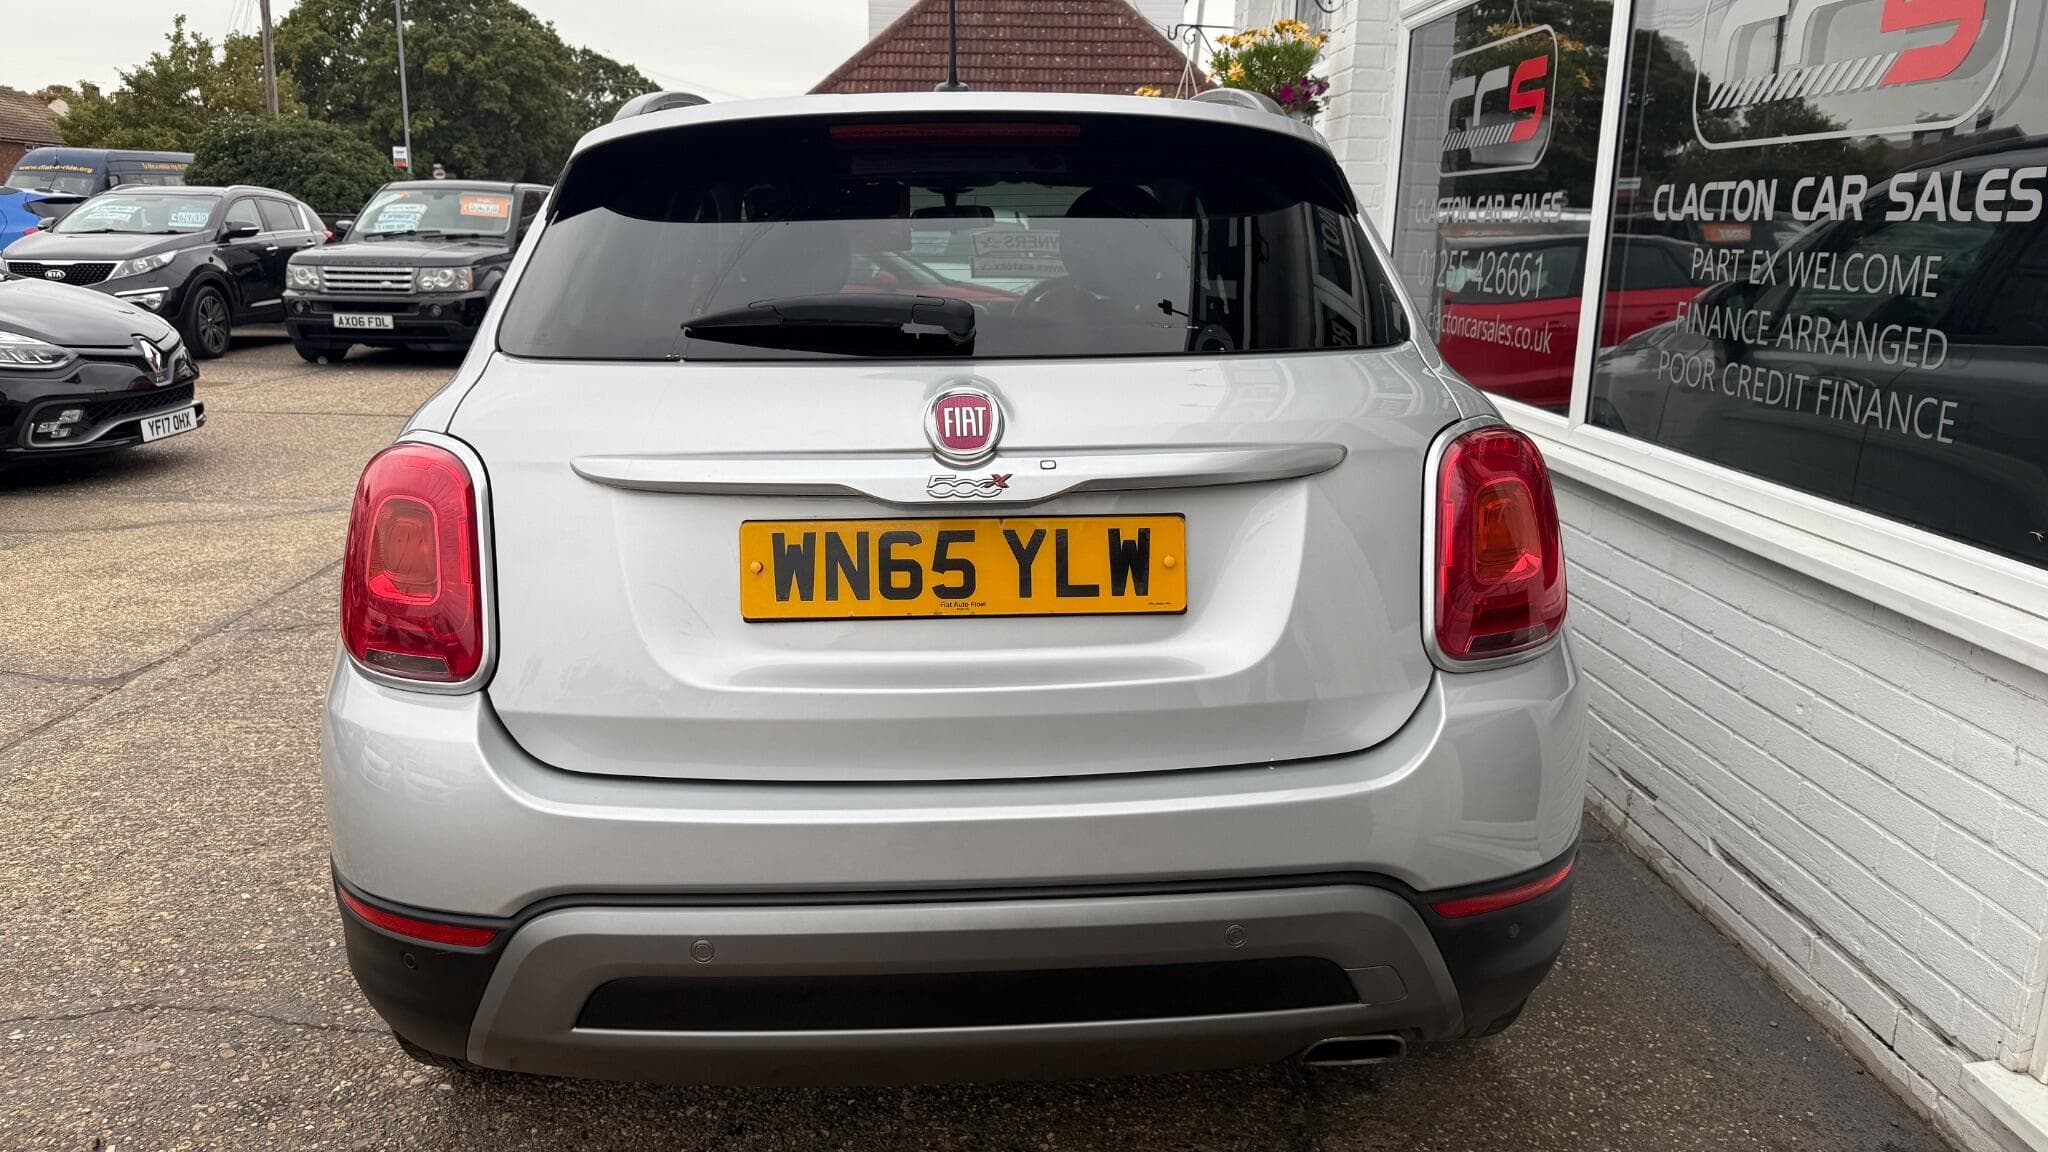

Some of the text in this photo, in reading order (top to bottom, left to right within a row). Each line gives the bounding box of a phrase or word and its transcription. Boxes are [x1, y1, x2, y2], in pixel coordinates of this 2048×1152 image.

[1416, 191, 1563, 224] CLACTON CAR SALES
[1653, 165, 2048, 223] CLACTON CAR SALES
[1418, 249, 1544, 299] 01255 426661
[1690, 247, 1943, 298] PART EX WELCOME
[338, 317, 389, 328] AX06 FDL
[1674, 301, 1948, 371] FINANCE ARRANGED
[943, 405, 987, 438] FIAT
[1658, 350, 1959, 445] POOR CREDIT FINANCE
[148, 411, 192, 437] YF17 OHX
[771, 527, 1152, 602] WN65 YLW
